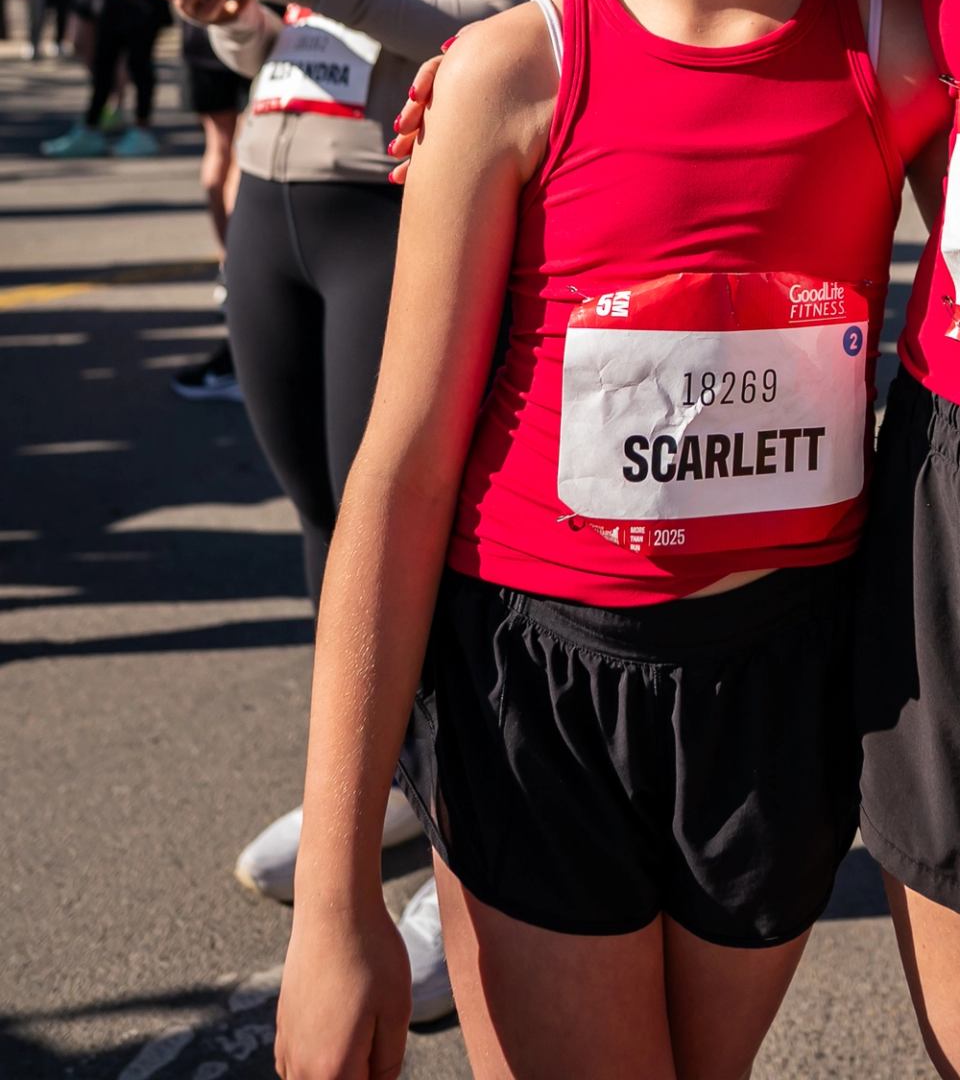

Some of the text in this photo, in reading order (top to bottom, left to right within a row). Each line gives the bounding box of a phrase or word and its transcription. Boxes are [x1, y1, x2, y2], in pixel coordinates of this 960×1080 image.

[789, 281, 845, 304] GoodLife
[849, 332, 858, 350] 2
[683, 368, 777, 407] 18269
[622, 426, 826, 483] SCARLETT
[654, 528, 685, 546] 2025
